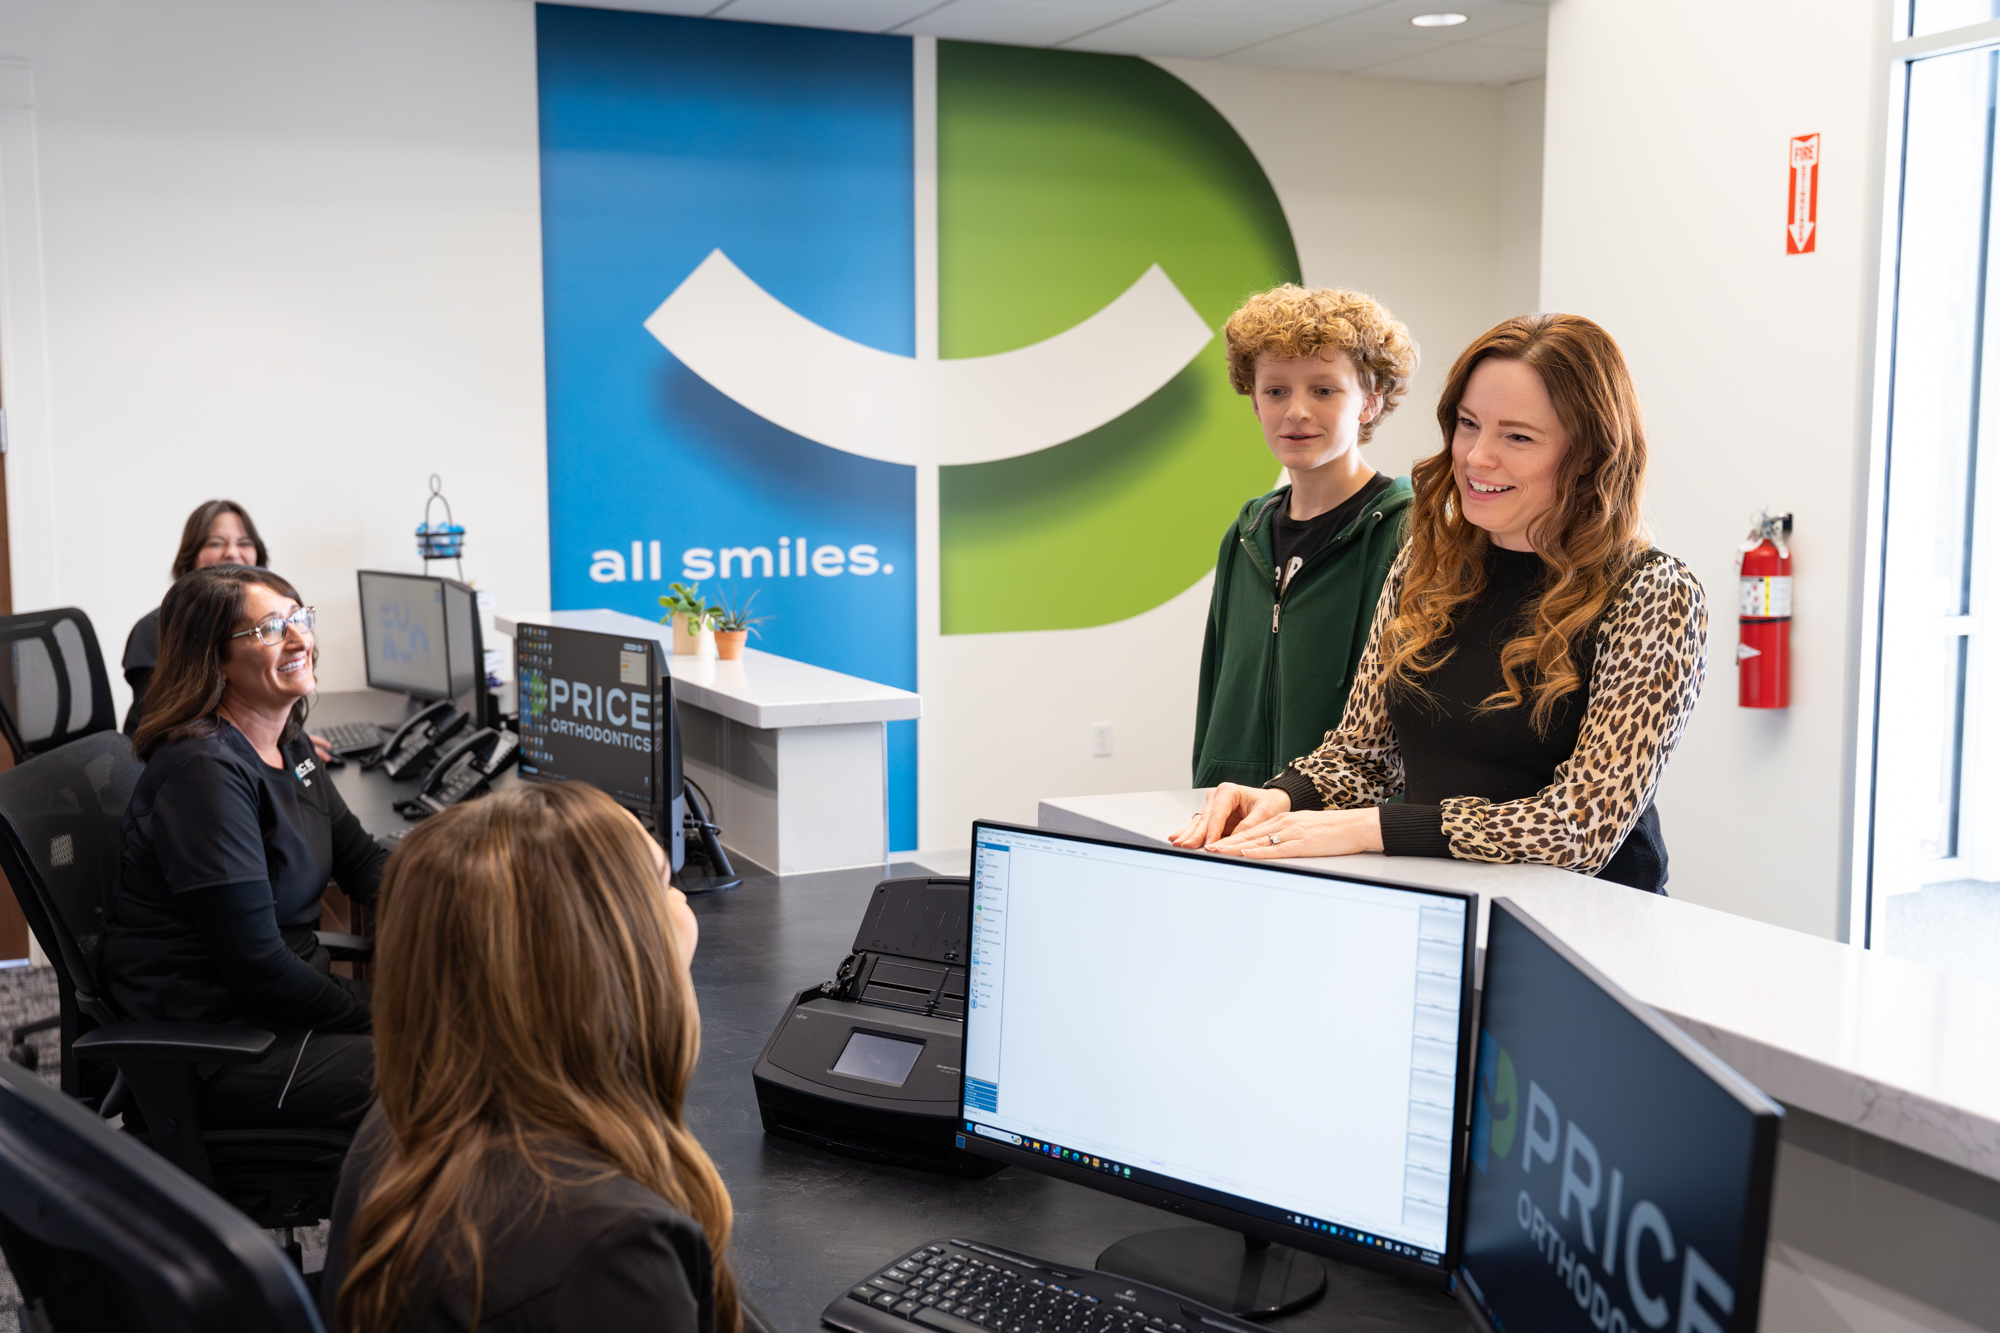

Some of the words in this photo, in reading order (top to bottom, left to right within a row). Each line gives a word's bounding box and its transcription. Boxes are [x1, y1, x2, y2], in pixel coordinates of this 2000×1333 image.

[1795, 145, 1814, 162] FIRE
[589, 540, 662, 583] all
[682, 536, 895, 580] smiles.
[550, 677, 651, 732] PRICE
[551, 717, 652, 753] ORTHODONTICS
[1517, 1190, 1640, 1333] ORTHODO
